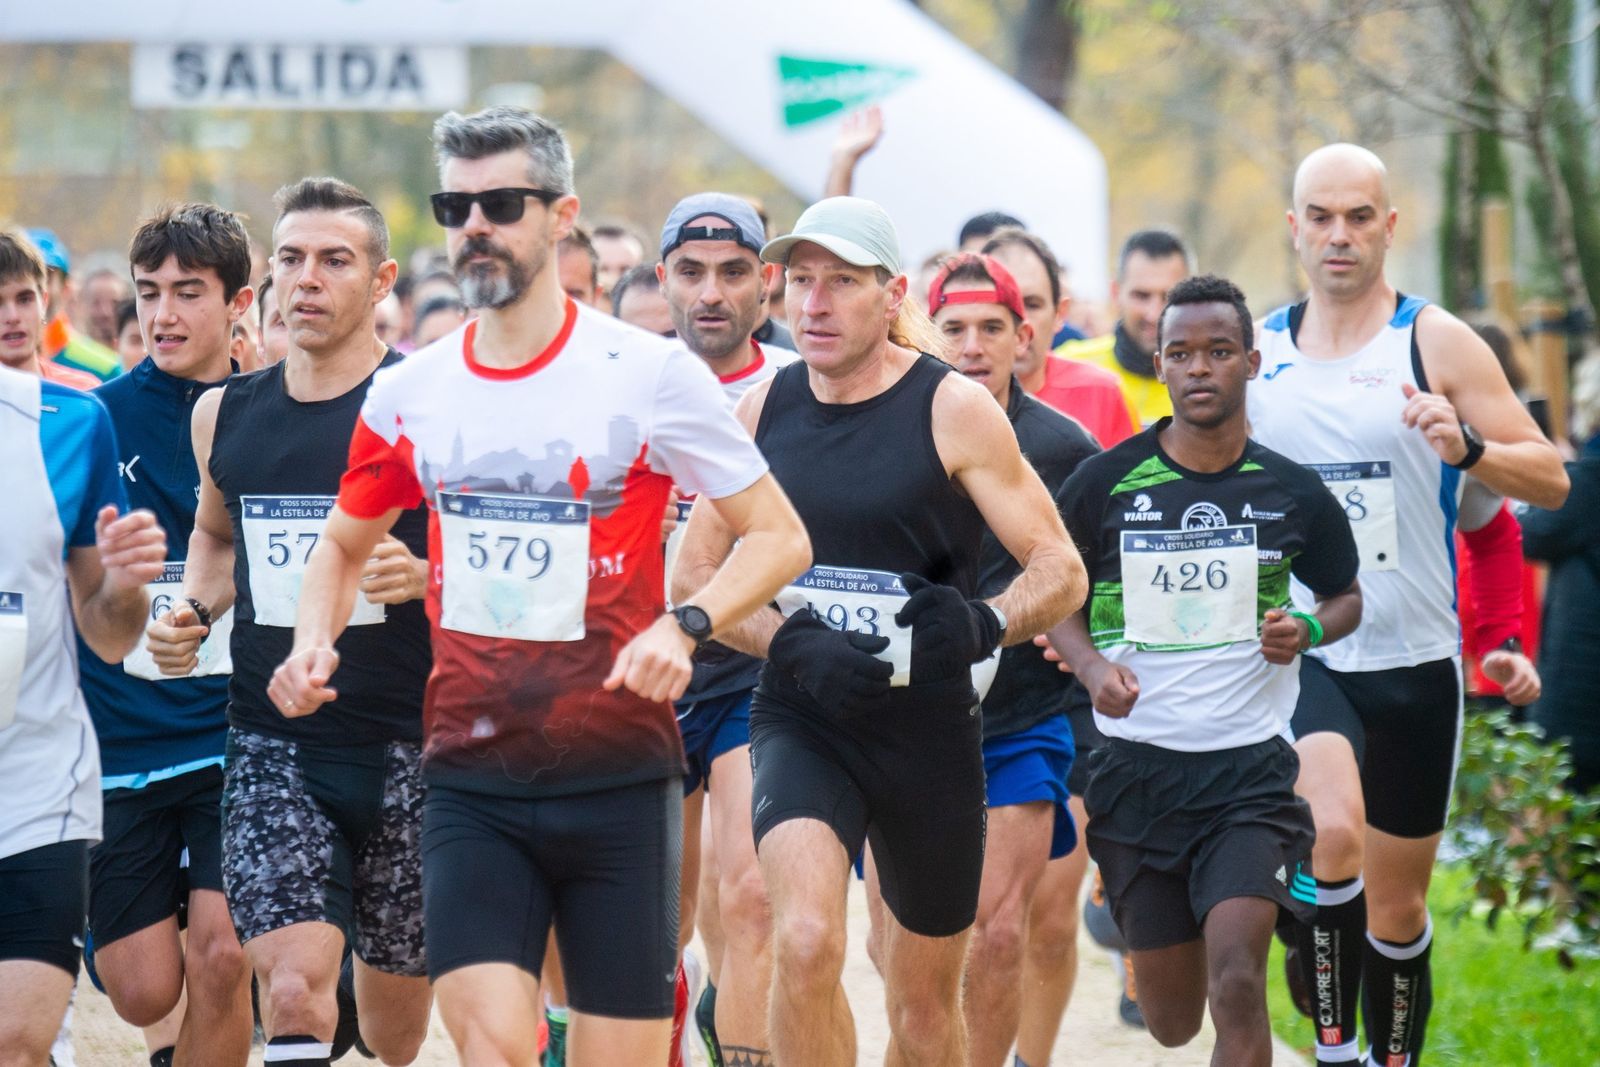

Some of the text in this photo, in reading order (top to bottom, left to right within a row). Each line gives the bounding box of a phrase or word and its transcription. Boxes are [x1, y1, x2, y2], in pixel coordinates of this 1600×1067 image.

[171, 44, 423, 97] SALIDA
[271, 509, 281, 517] LA
[283, 509, 311, 517] ESTELA
[314, 509, 325, 517] DE
[469, 508, 550, 521] LA ESTELA DE AYO
[1124, 511, 1163, 521] VIATOR
[1155, 538, 1224, 551] LA ESTELA DE AYO
[468, 530, 551, 580] 579
[814, 570, 868, 580] CROSS SOLIDARIO
[1151, 559, 1228, 592] 426
[804, 578, 878, 591] LA ESTELA DE AYO
[808, 602, 879, 636] 93
